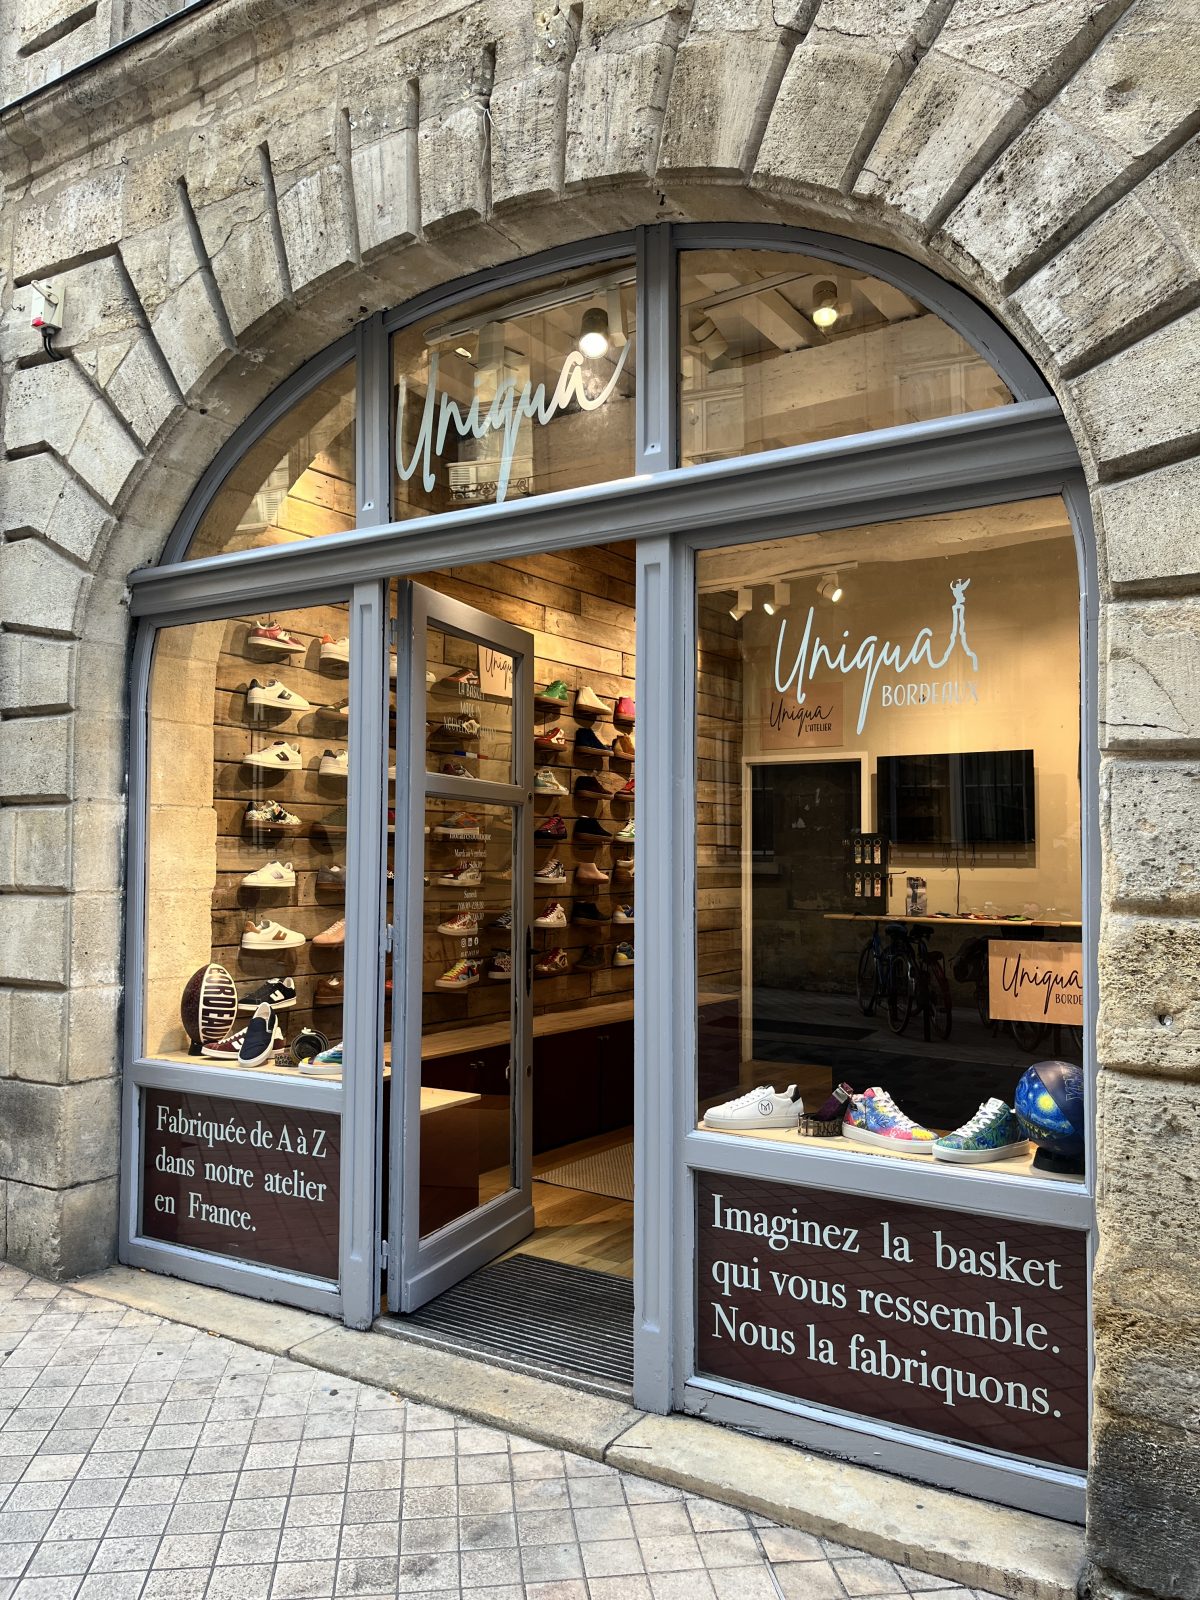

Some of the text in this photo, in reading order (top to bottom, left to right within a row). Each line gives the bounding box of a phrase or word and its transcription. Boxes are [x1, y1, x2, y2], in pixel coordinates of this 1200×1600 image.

[396, 340, 631, 502] Uniqua
[775, 606, 954, 734] Uniqua
[881, 680, 979, 707] BORDEAUX
[770, 698, 834, 737] Uniqua
[1002, 953, 1083, 1015] Uniqua
[1055, 993, 1083, 1005] BORDE
[156, 1104, 327, 1158] Fabriquée de A à Z
[155, 1146, 327, 1202] dans notre atelier
[154, 1191, 257, 1232] en France.
[711, 1193, 1063, 1290] Imaginez la basket
[711, 1257, 1061, 1354] qui vous ressemble.
[711, 1302, 1063, 1418] Nous la fabriquons.
